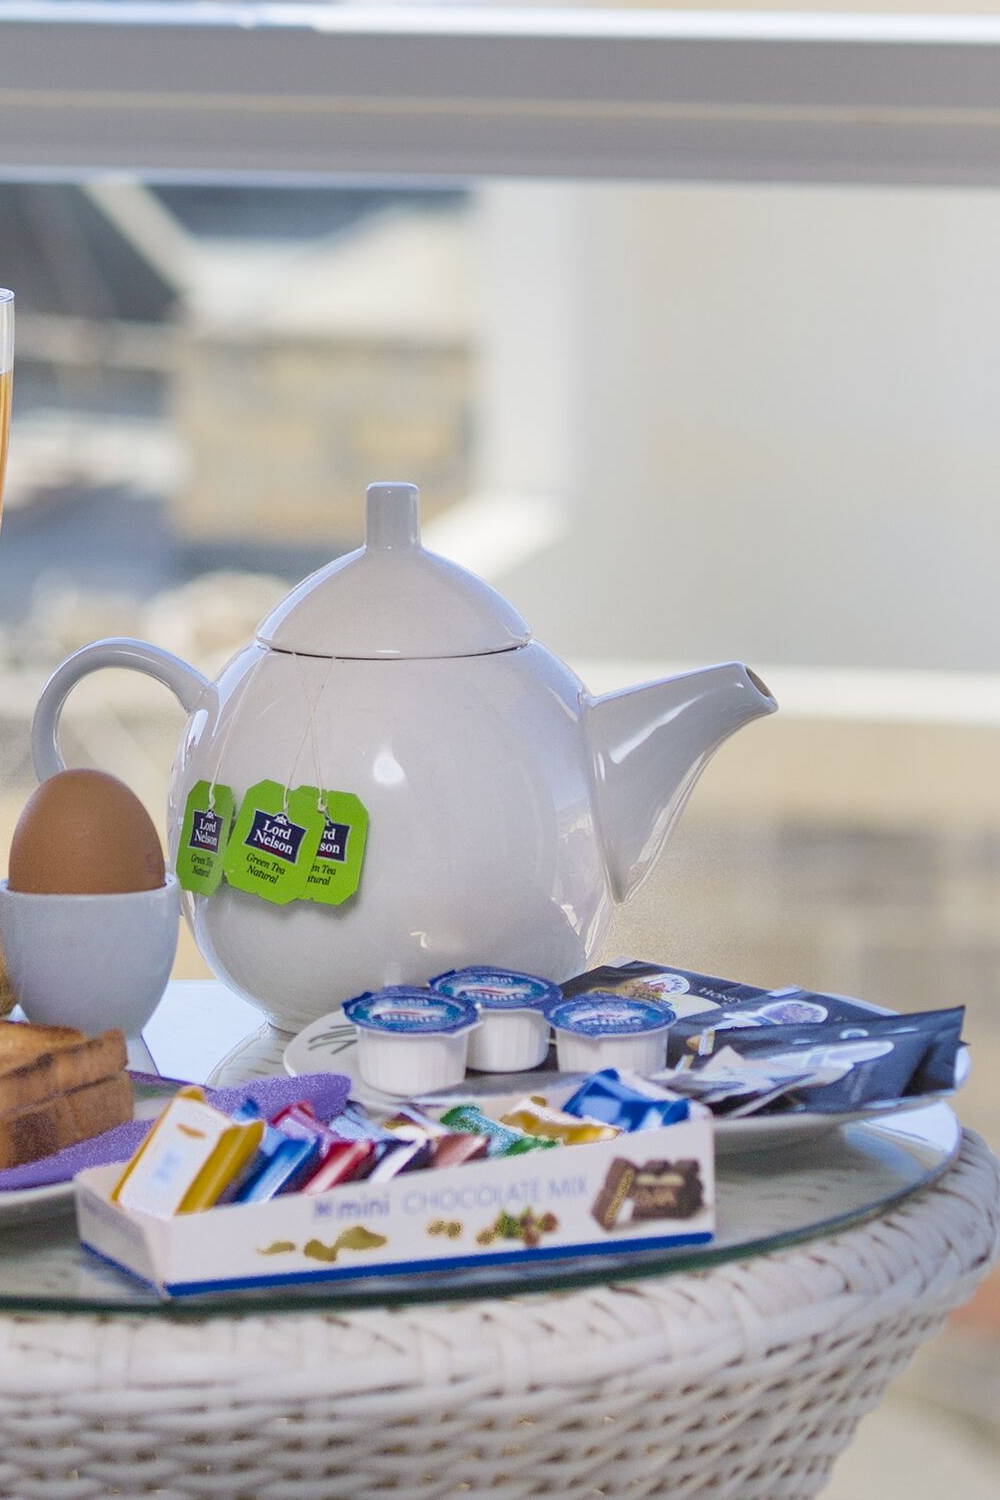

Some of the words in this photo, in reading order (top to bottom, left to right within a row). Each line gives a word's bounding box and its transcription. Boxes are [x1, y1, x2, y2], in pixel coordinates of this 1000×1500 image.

[199, 818, 217, 833] Lord
[263, 820, 292, 840] Lord
[194, 829, 218, 847] Nelson
[253, 829, 293, 855] Nelson
[246, 853, 270, 869] Green
[272, 862, 286, 875] Tea
[322, 864, 336, 875] Tea
[246, 865, 280, 884] Natural
[336, 1192, 390, 1220] mini
[402, 1177, 538, 1215] CHOCOLATE
[548, 1175, 587, 1198] MIX
